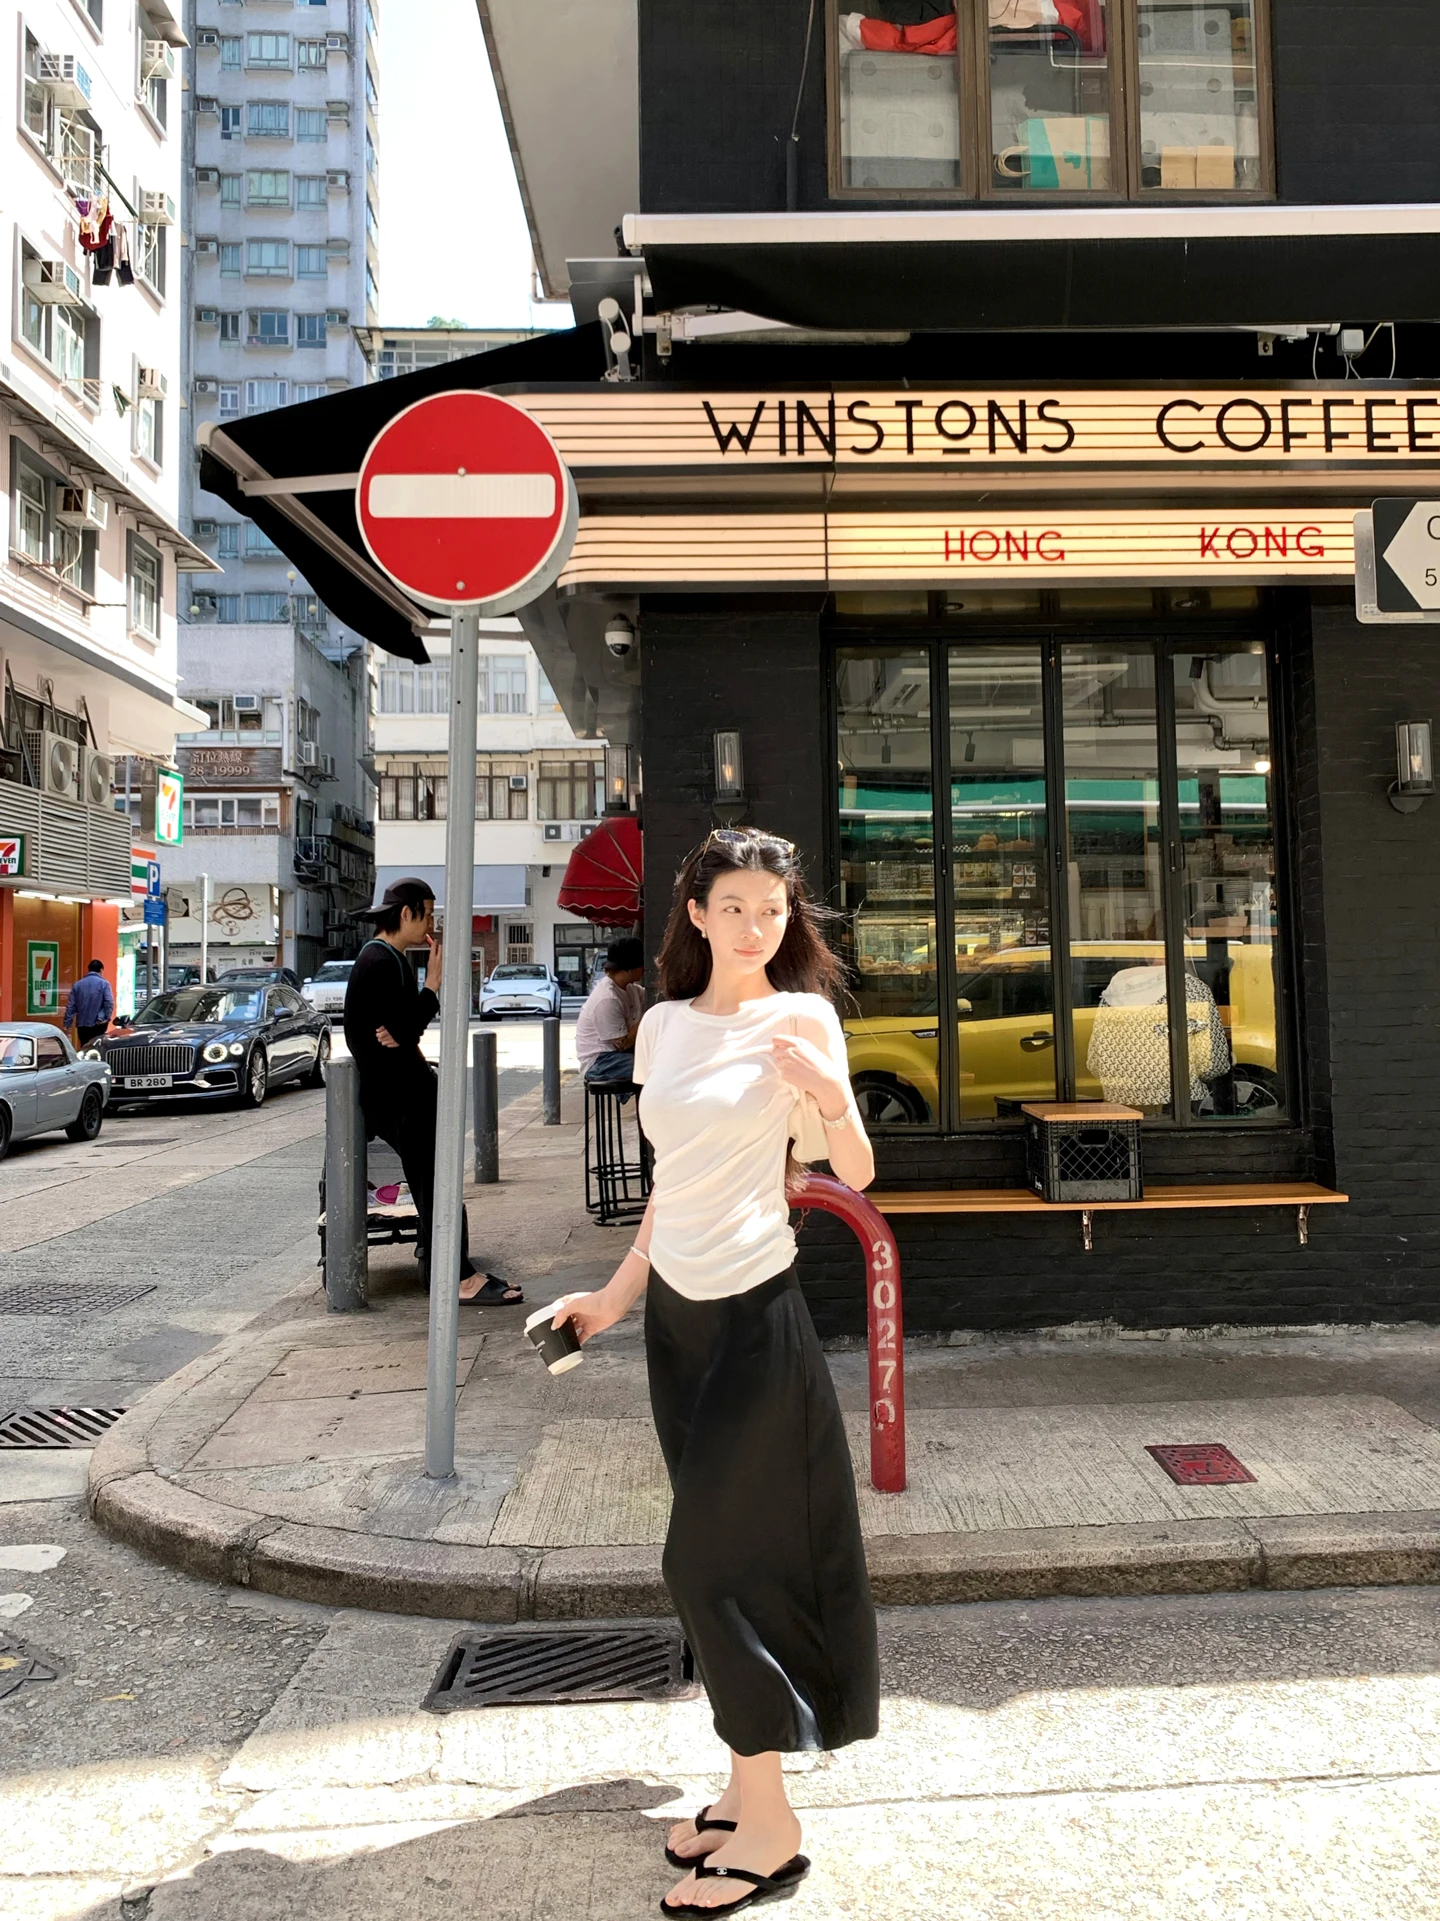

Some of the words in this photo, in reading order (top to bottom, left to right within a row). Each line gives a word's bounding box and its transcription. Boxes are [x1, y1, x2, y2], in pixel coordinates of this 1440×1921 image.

[702, 399, 1075, 455] WINSTONS
[1156, 398, 1440, 453] COFFEE
[944, 529, 1065, 562] HONG
[1200, 526, 1324, 559] KONG
[149, 864, 159, 893] P
[130, 1079, 143, 1087] BR
[146, 1077, 167, 1087] 280
